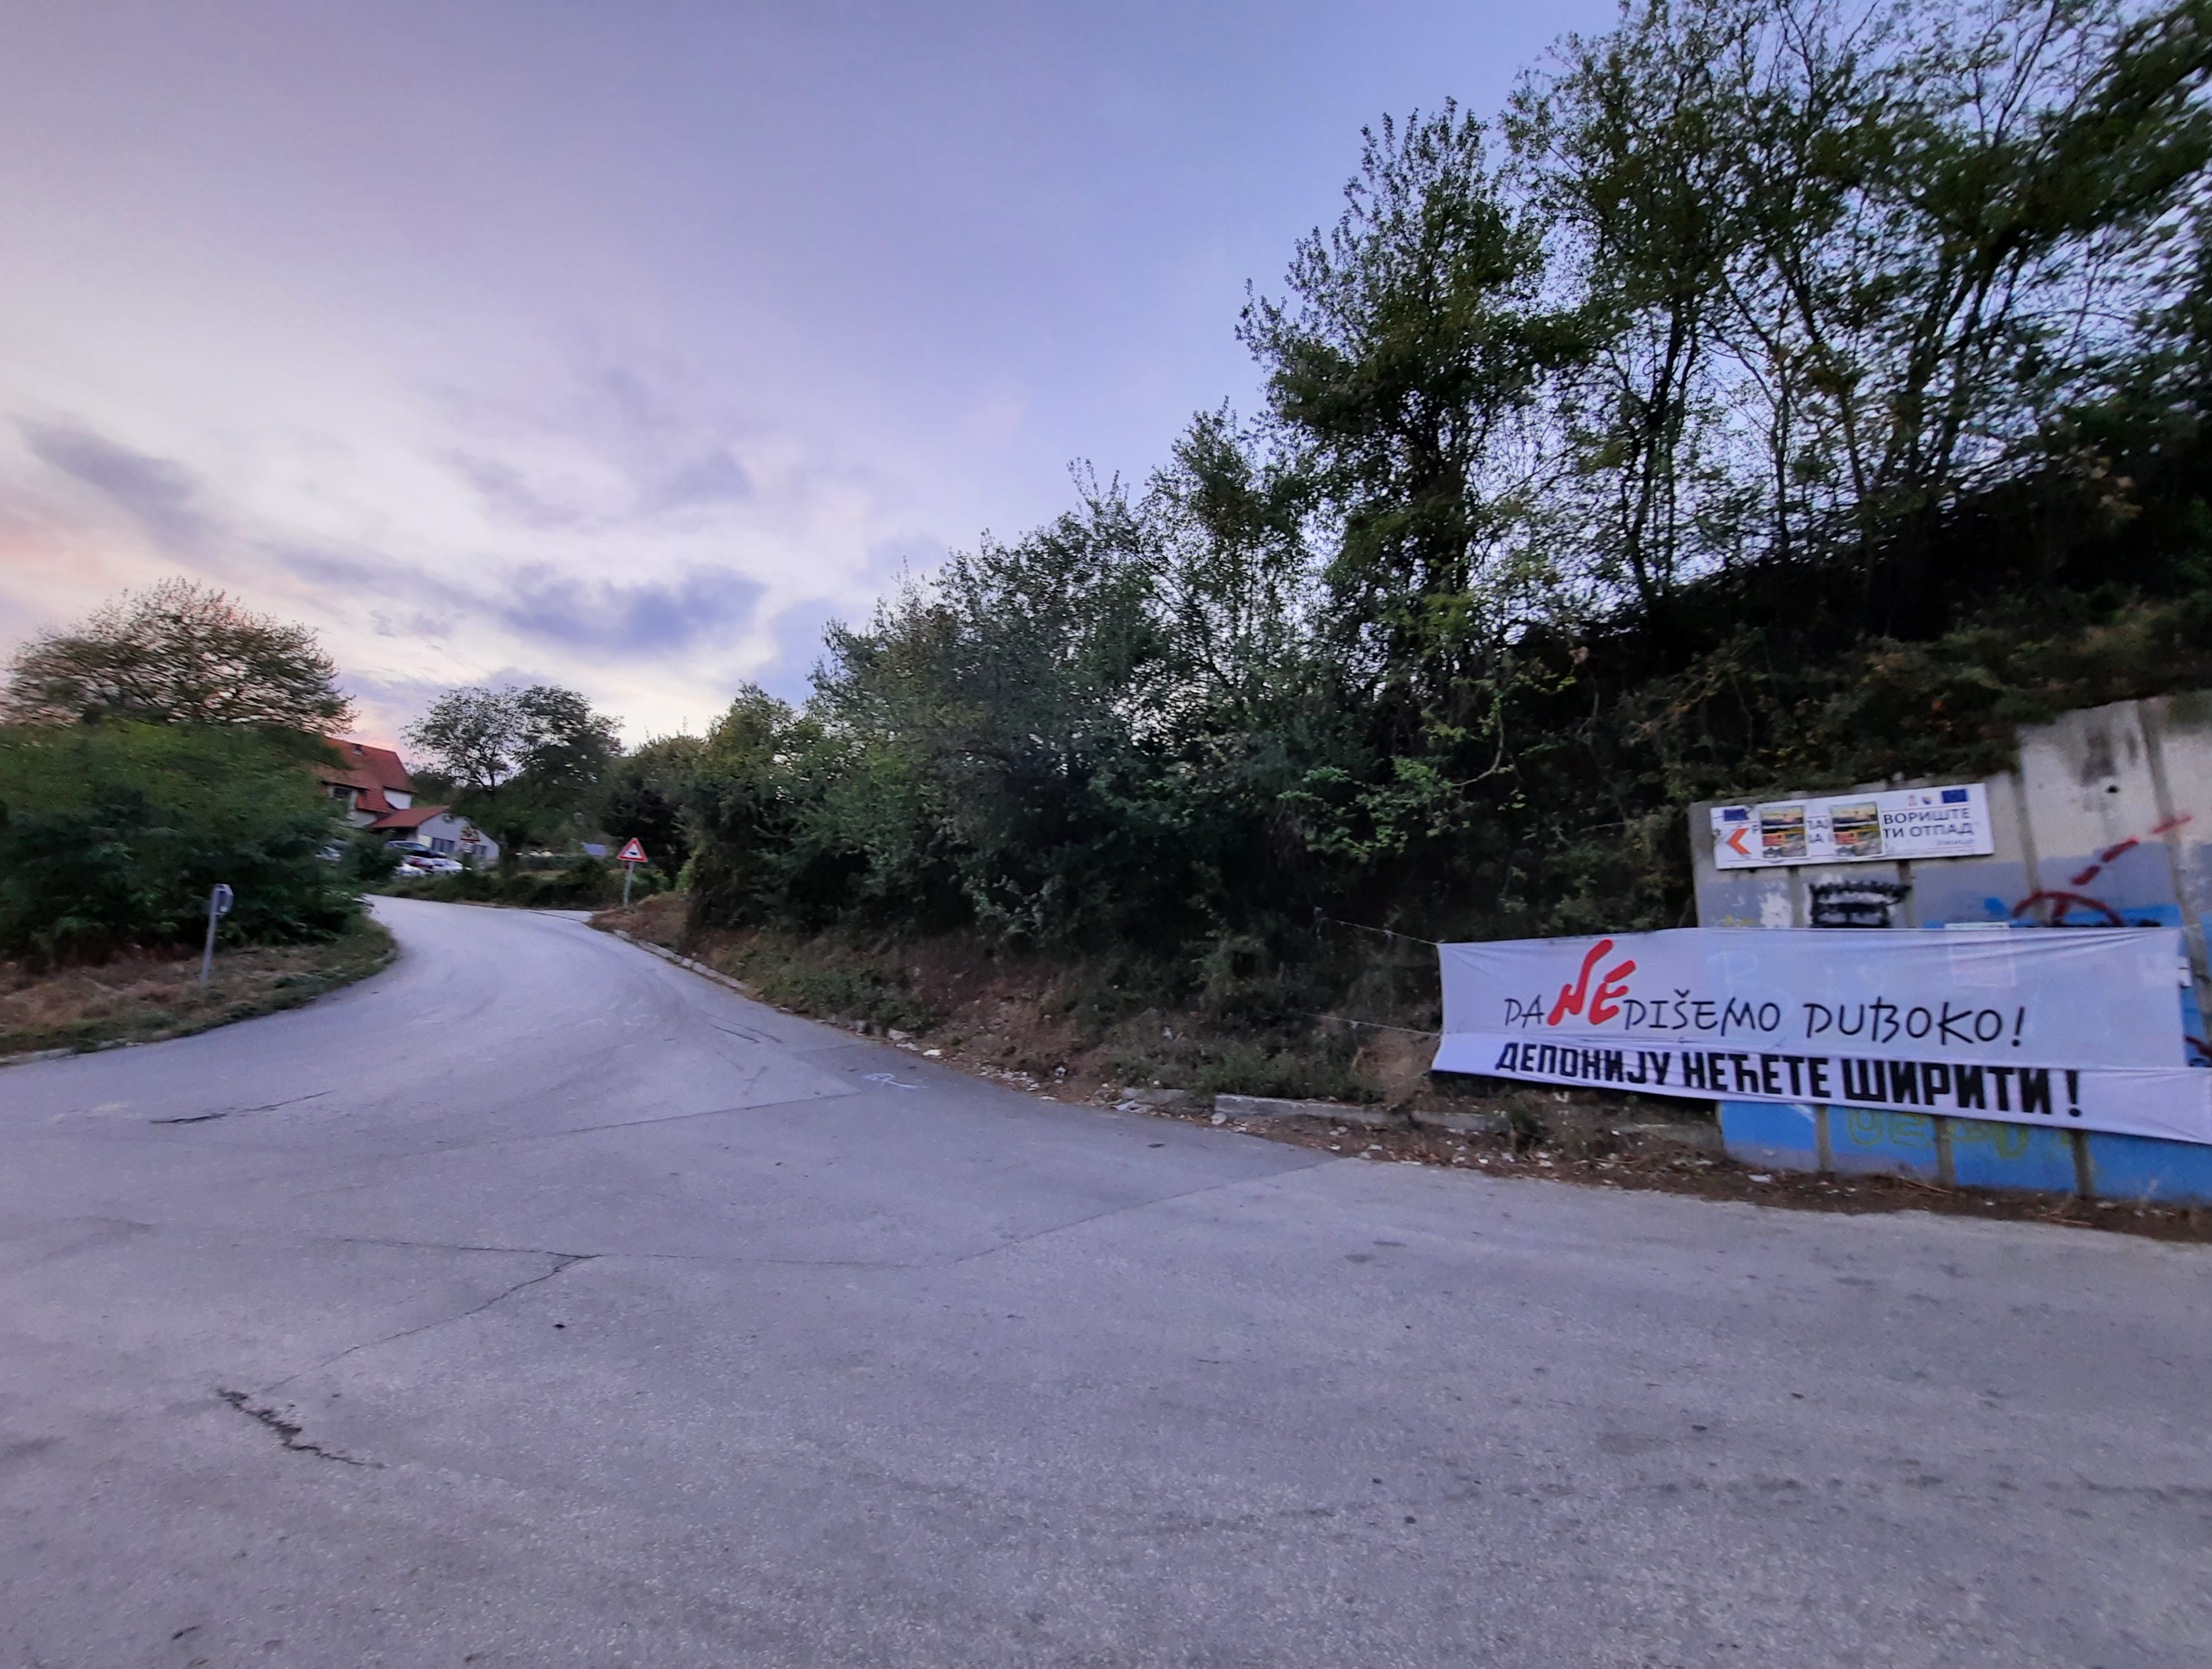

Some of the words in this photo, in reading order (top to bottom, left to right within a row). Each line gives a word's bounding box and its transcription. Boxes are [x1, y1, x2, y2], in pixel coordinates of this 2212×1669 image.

[1883, 808, 1970, 825] ВОРИШТЕ
[1503, 994, 1545, 1028] DA
[1547, 939, 1637, 1026] NE
[1623, 988, 1781, 1037] DIŠEMO
[1494, 1042, 1671, 1085] ДЕПОНИЈУ
[1682, 1051, 1831, 1098] НЕЋЕТЕ
